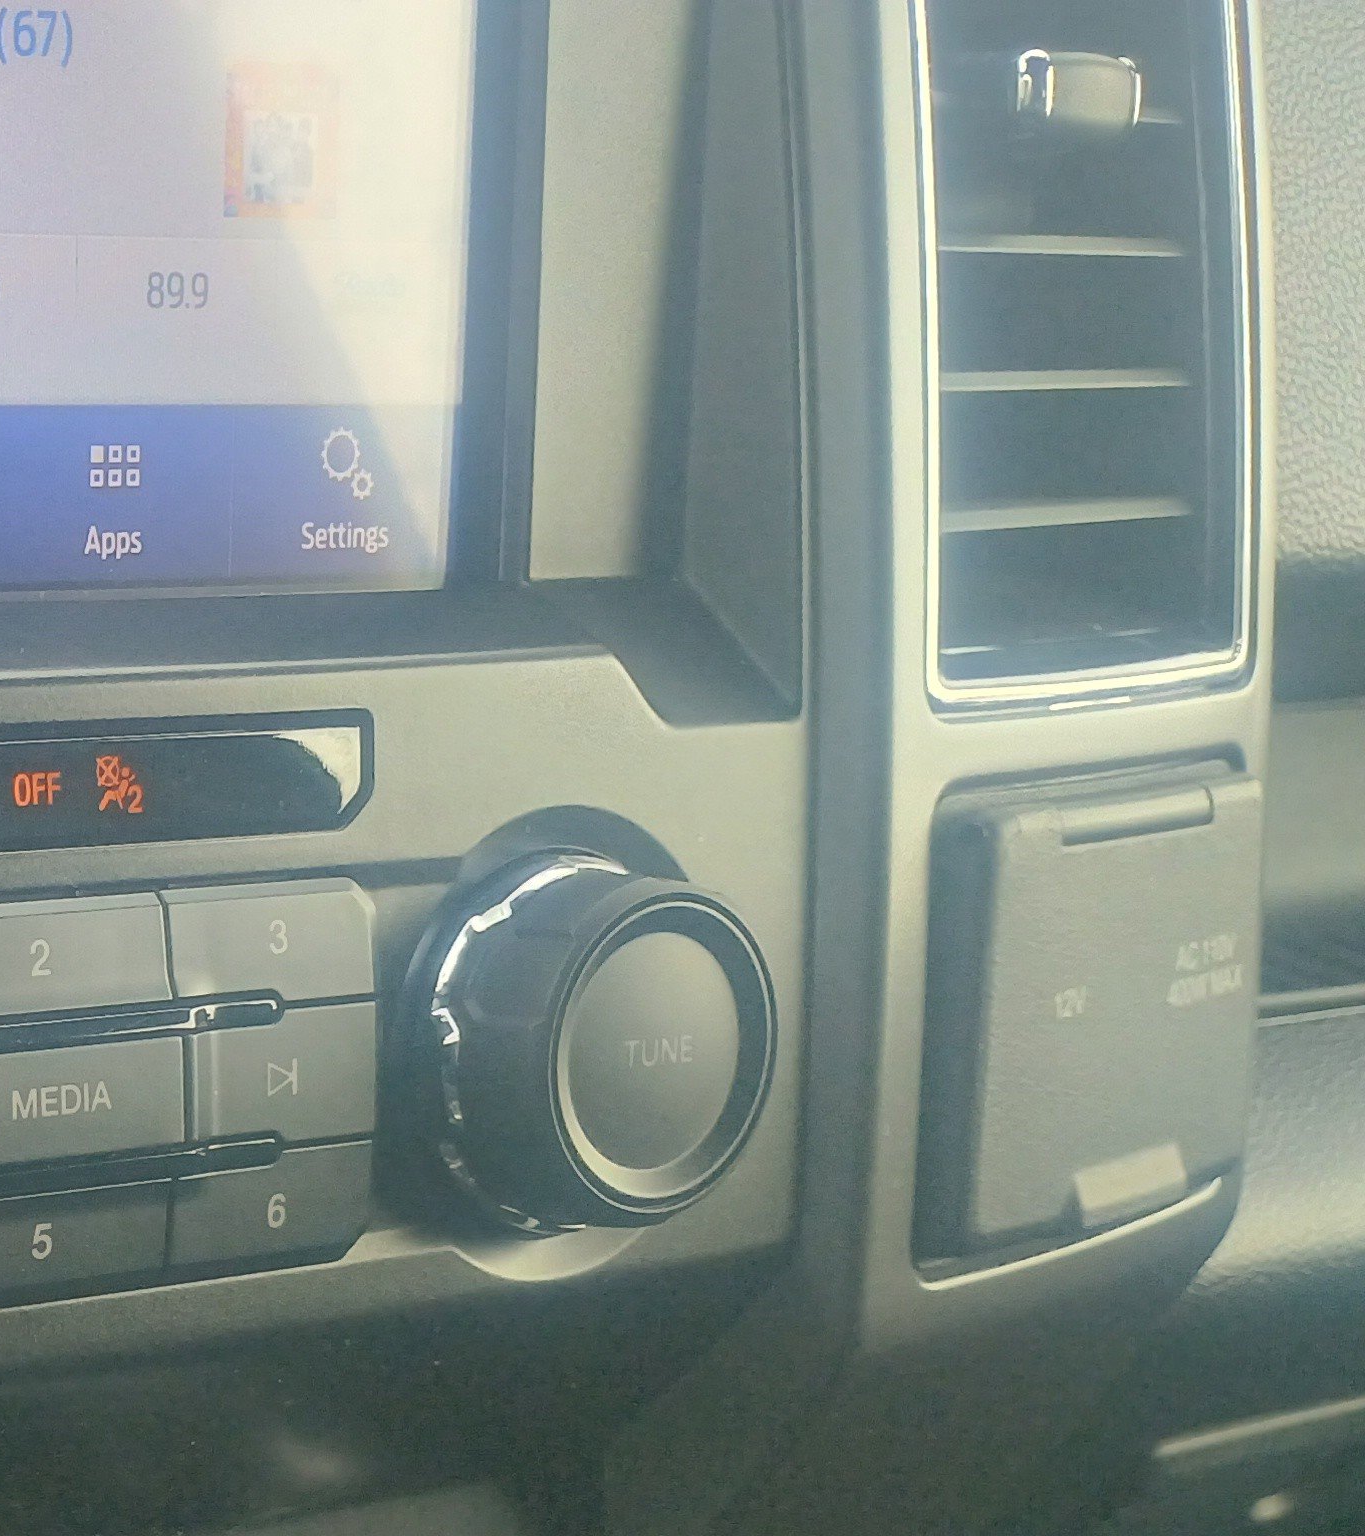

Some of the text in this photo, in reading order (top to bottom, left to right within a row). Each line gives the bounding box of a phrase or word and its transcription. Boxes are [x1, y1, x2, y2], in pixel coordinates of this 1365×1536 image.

[146, 271, 210, 310] 89.9
[83, 525, 143, 560] Apps
[300, 521, 390, 554] Settings
[13, 770, 62, 808] OFF
[267, 918, 289, 955] 3
[29, 938, 53, 978] 2
[623, 1034, 694, 1070] TUNE
[11, 1079, 113, 1122] MEDIA
[266, 1192, 288, 1229] 6
[31, 1222, 54, 1261] 5
